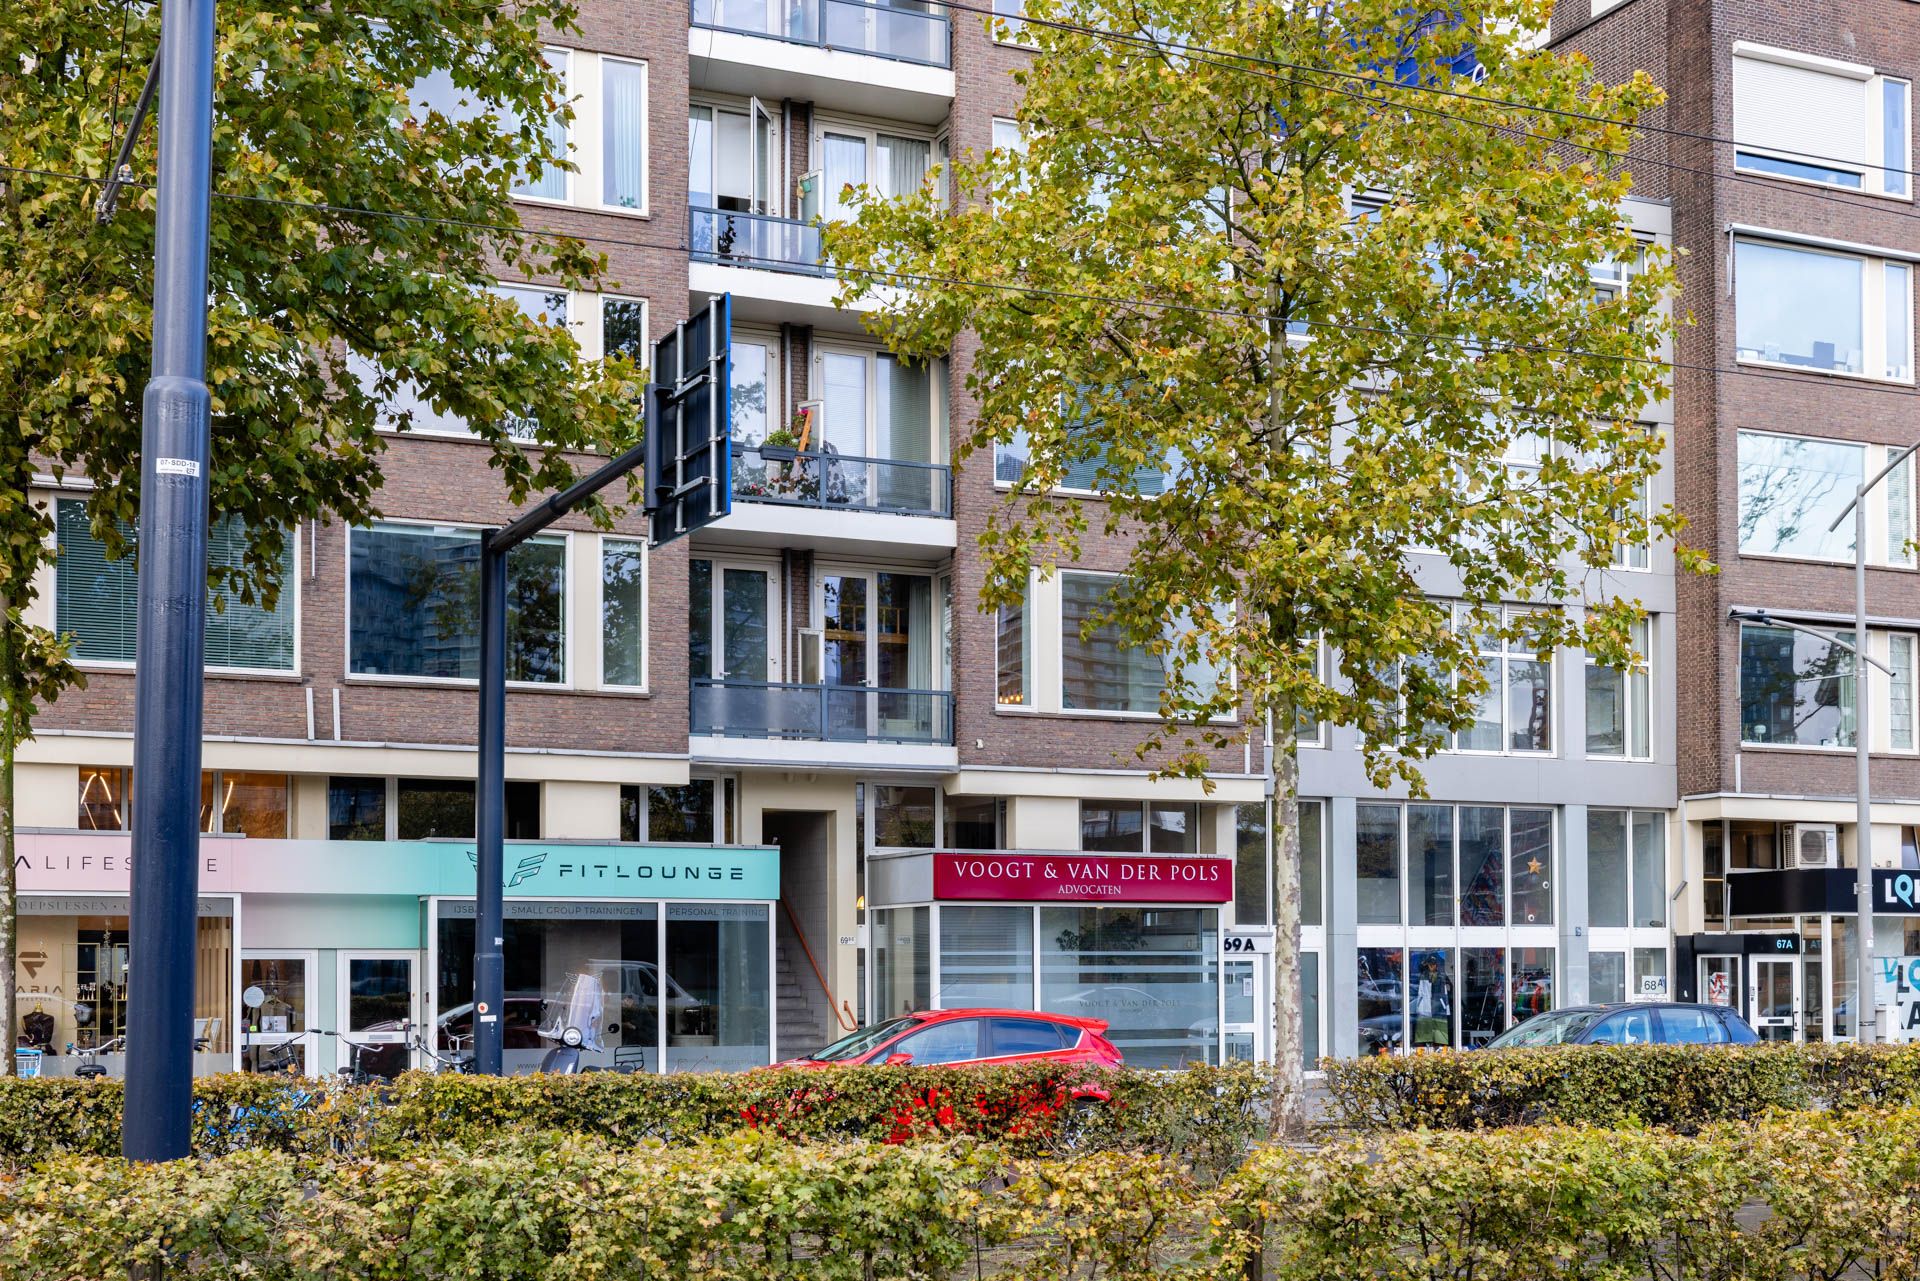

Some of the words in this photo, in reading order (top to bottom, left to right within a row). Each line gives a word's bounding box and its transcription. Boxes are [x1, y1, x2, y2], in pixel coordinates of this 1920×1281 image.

[559, 864, 743, 880] FITLOUNGE
[953, 861, 1034, 878] VOOGT
[1044, 862, 1059, 879] &
[1068, 863, 1109, 880] VAN
[1121, 864, 1162, 881] DER
[1170, 865, 1219, 881] POLS
[1058, 884, 1122, 895] ADVOCATEN
[511, 906, 544, 915] SMALL
[546, 906, 581, 915] GROUP
[584, 906, 643, 916] TRAININGEN
[669, 907, 719, 916] PERSONAL
[721, 908, 766, 917] TRAINING
[1776, 939, 1793, 949] 67A
[16, 985, 63, 994] ARIA
